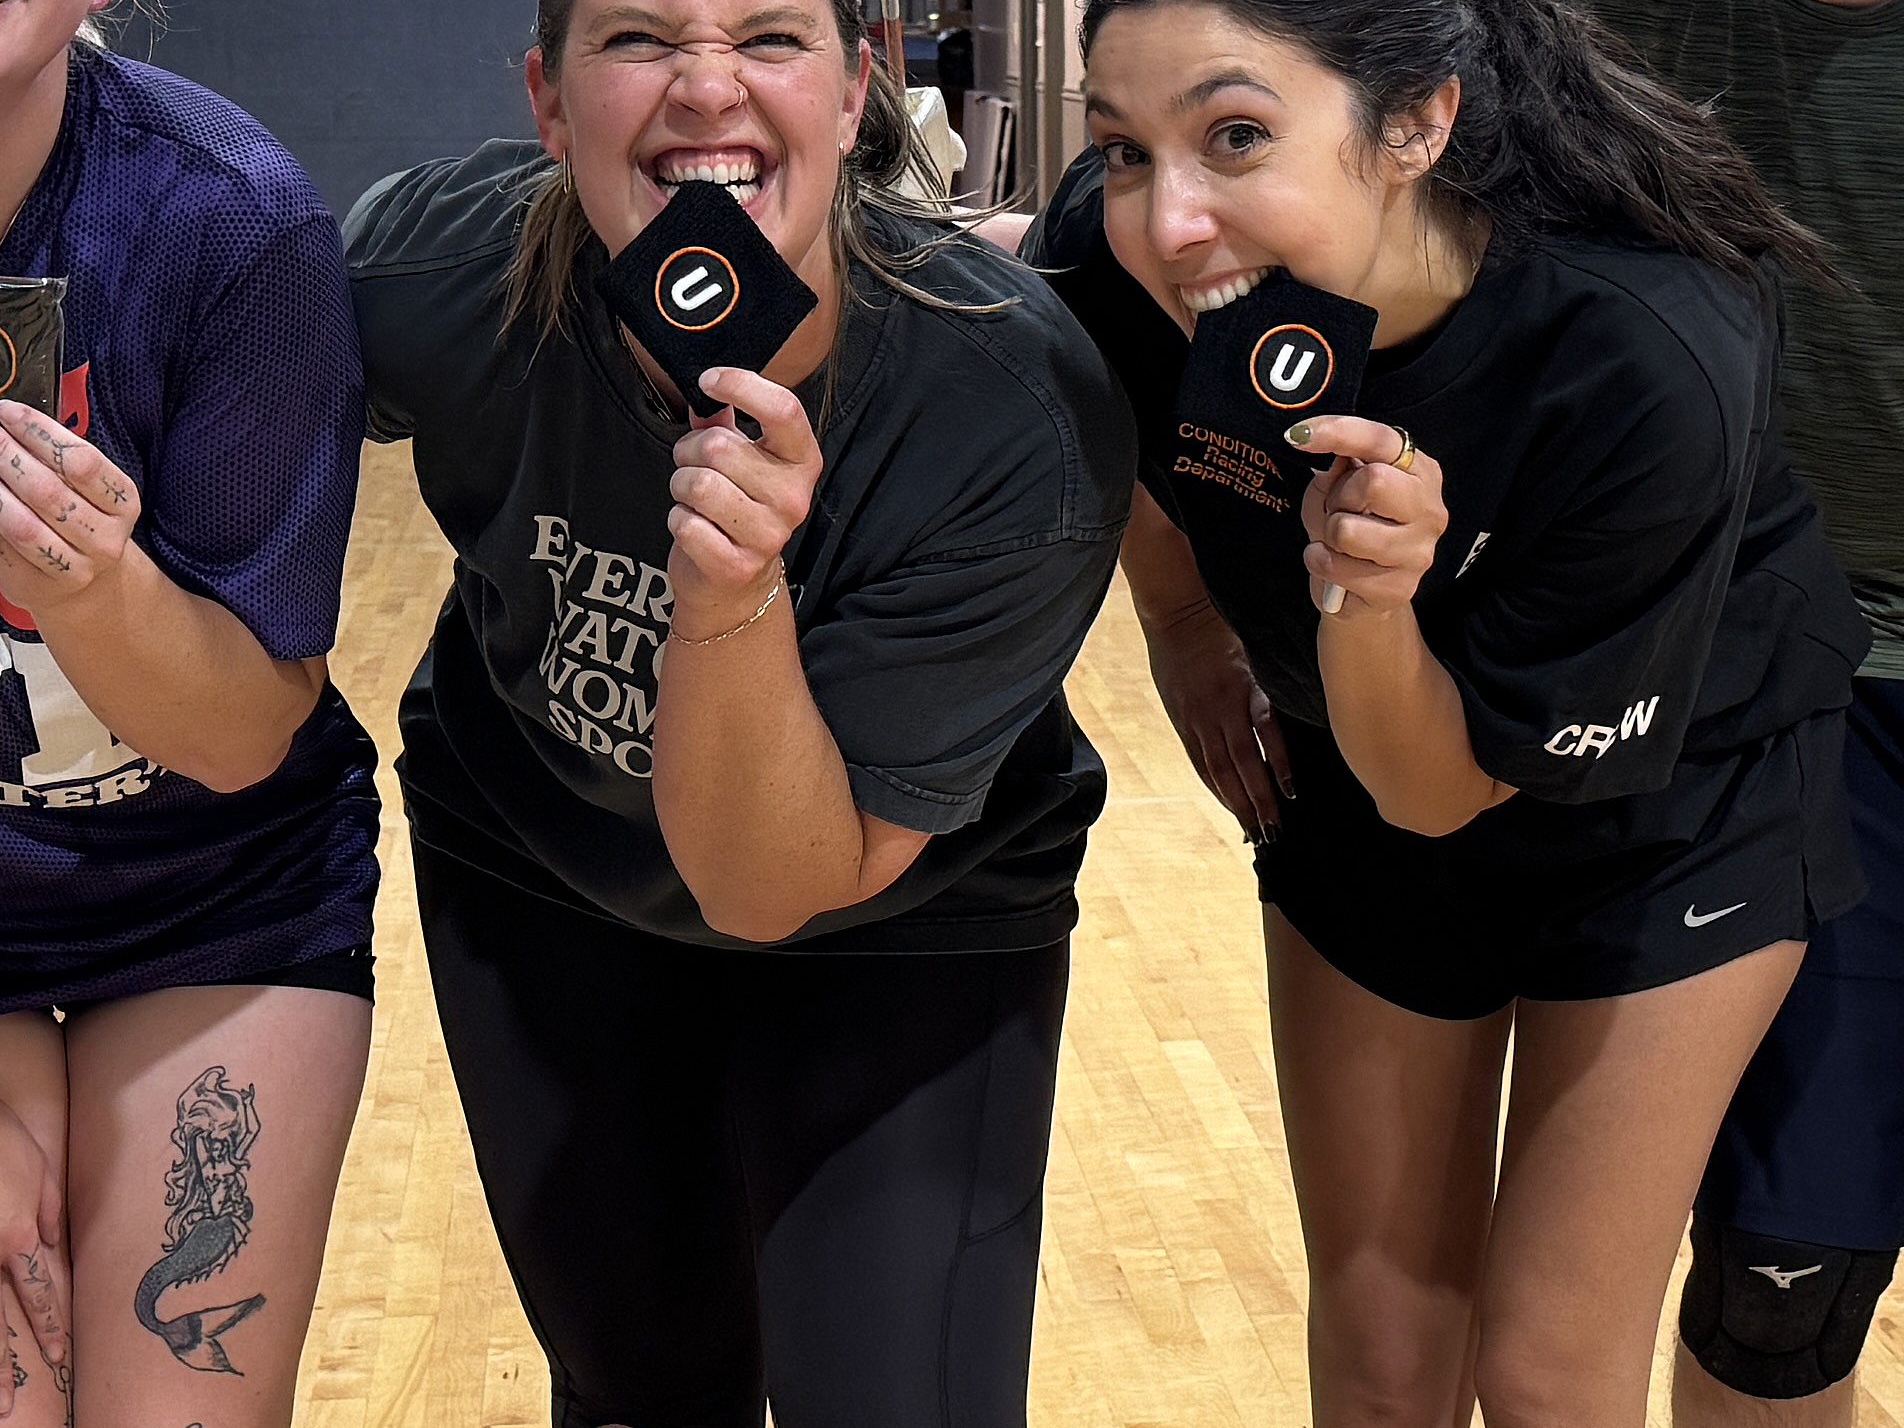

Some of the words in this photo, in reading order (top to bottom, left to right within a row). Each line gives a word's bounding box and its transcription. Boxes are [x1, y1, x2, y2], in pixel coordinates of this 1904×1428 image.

[671, 265, 723, 311] U
[1269, 342, 1316, 391] U
[529, 514, 676, 624] EVER
[538, 622, 657, 735] WOM
[548, 699, 653, 779] SPO
[1543, 694, 1661, 760] CRW
